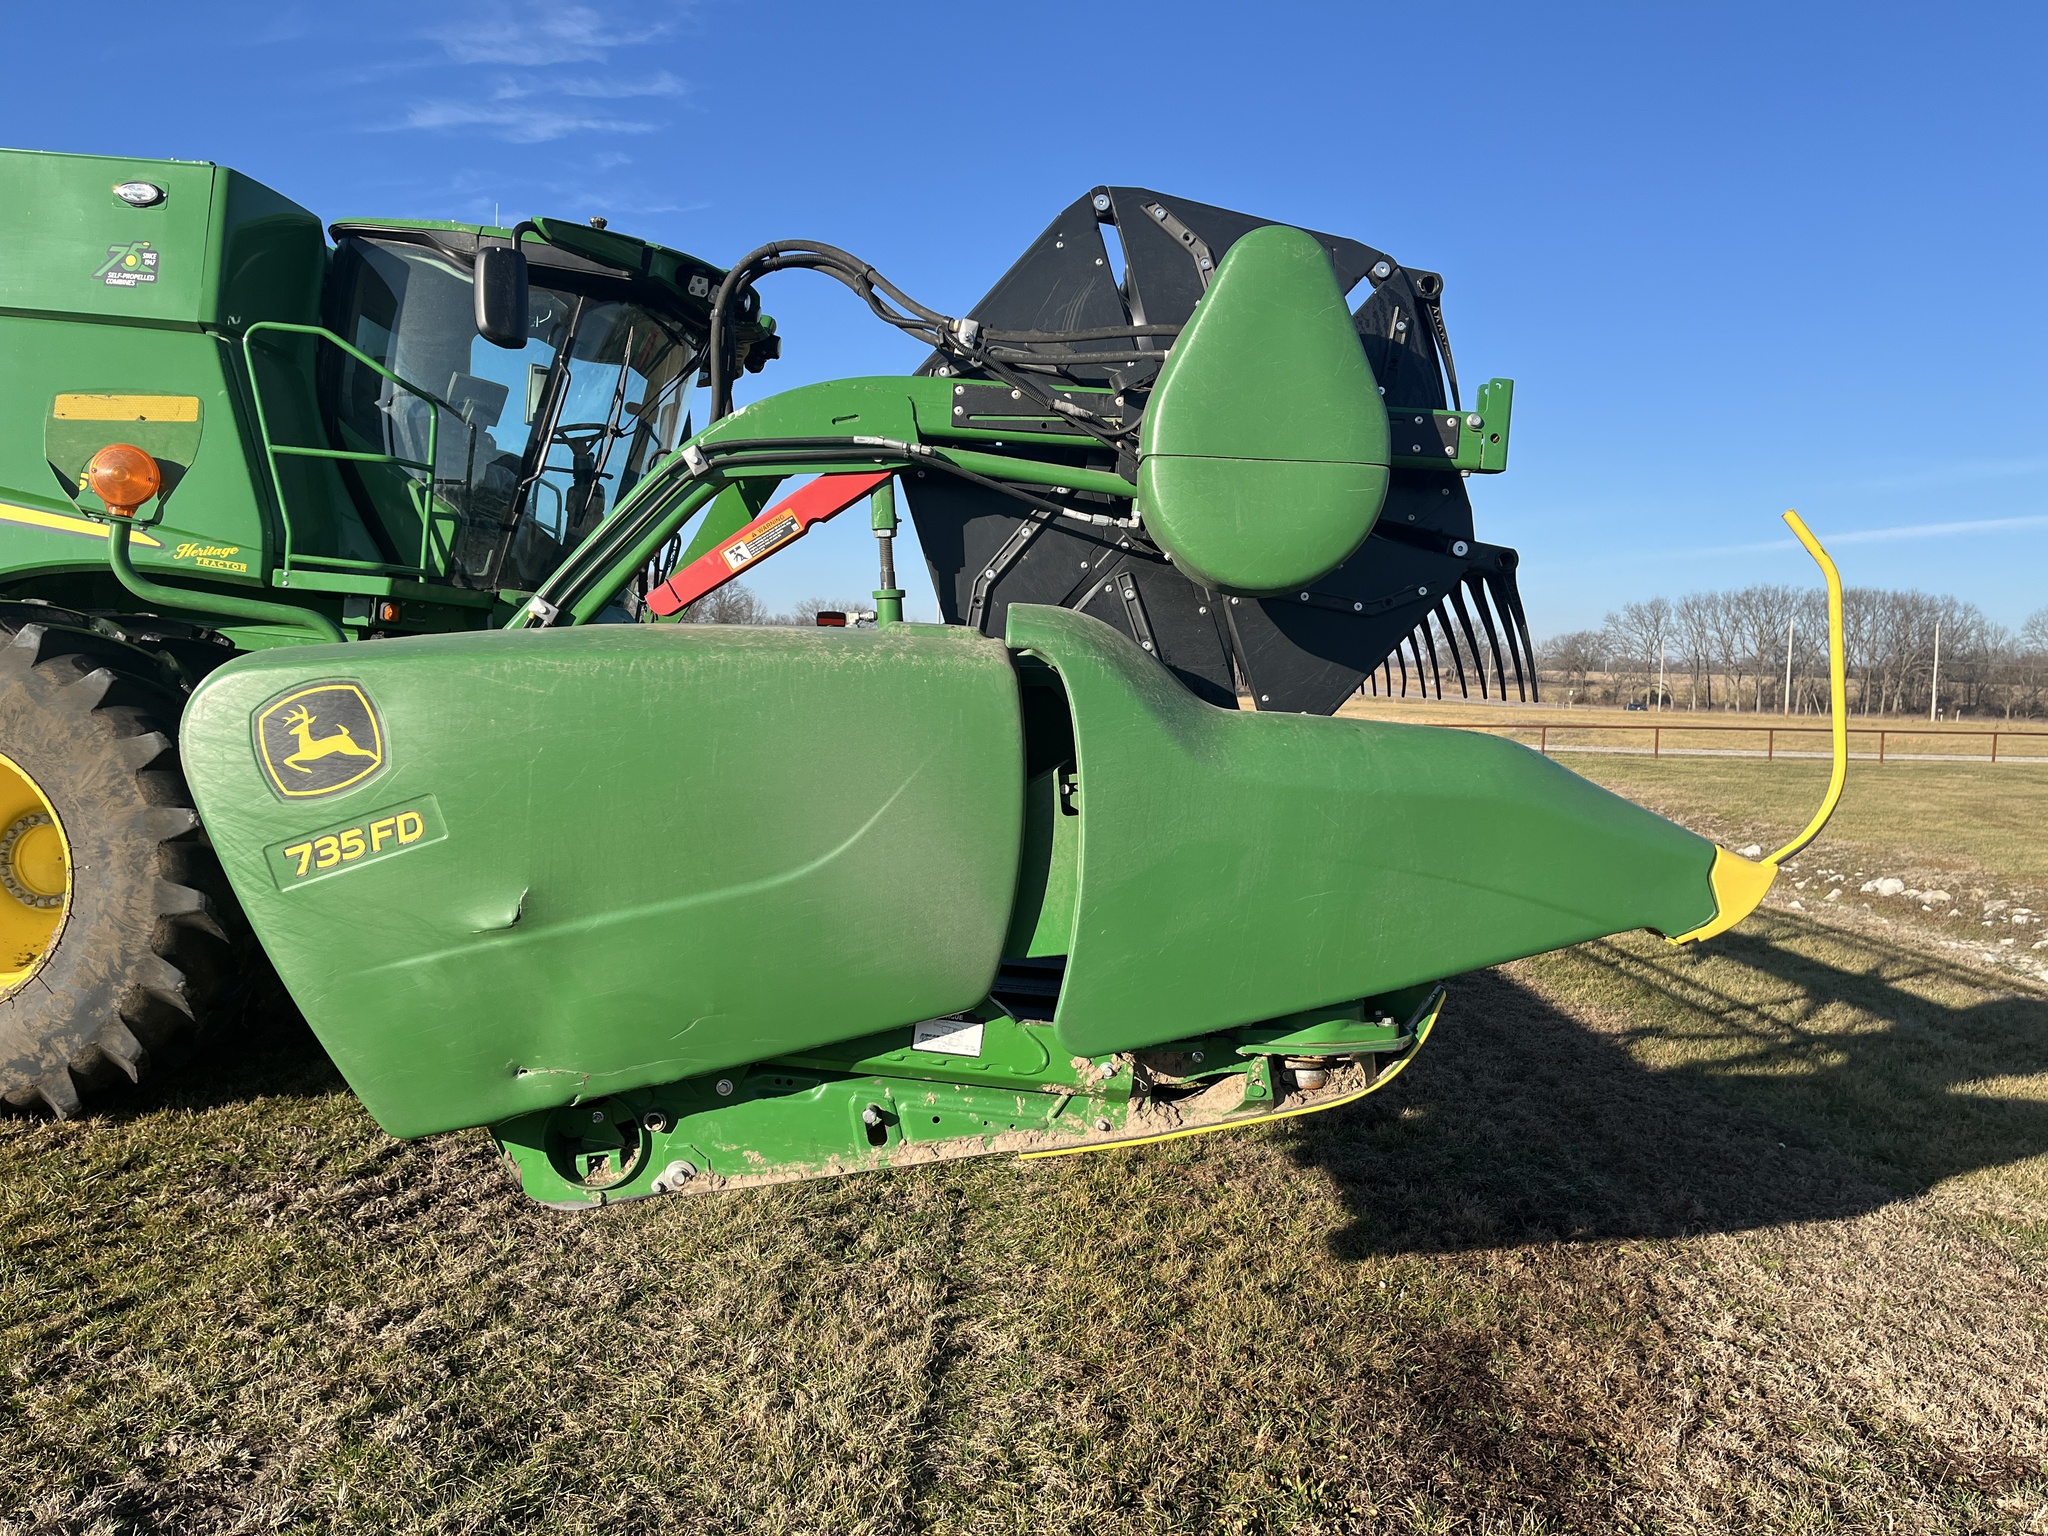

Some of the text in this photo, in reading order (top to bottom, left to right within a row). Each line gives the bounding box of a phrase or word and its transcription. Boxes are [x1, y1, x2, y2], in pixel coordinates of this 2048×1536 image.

[107, 272, 155, 281] SELF-PROPELLED
[757, 514, 786, 534] WARNING
[173, 543, 239, 560] Heritage
[196, 557, 247, 572] TRACTOR
